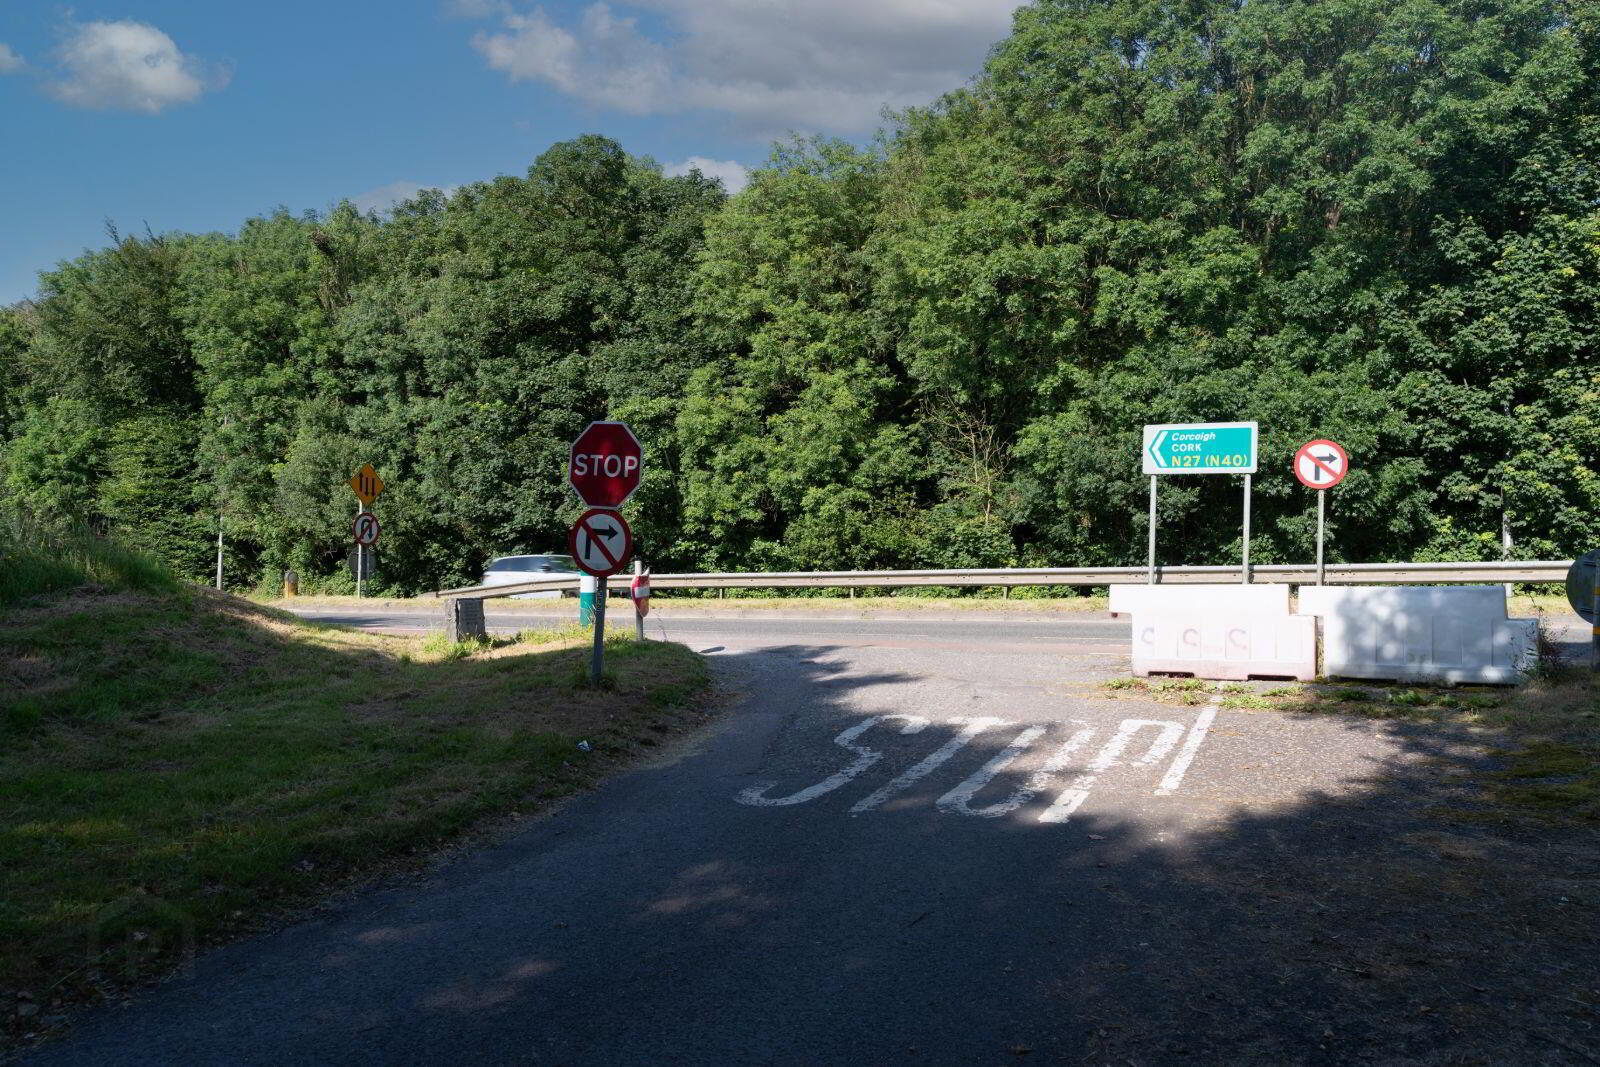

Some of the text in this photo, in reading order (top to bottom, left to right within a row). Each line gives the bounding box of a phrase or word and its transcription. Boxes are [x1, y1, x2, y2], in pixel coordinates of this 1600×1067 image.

[1171, 431, 1216, 442] Corcaigh
[1171, 443, 1202, 452] CORK
[574, 453, 639, 478] STOP
[1171, 453, 1248, 467] N27 (N40)
[733, 713, 1186, 825] STOP
